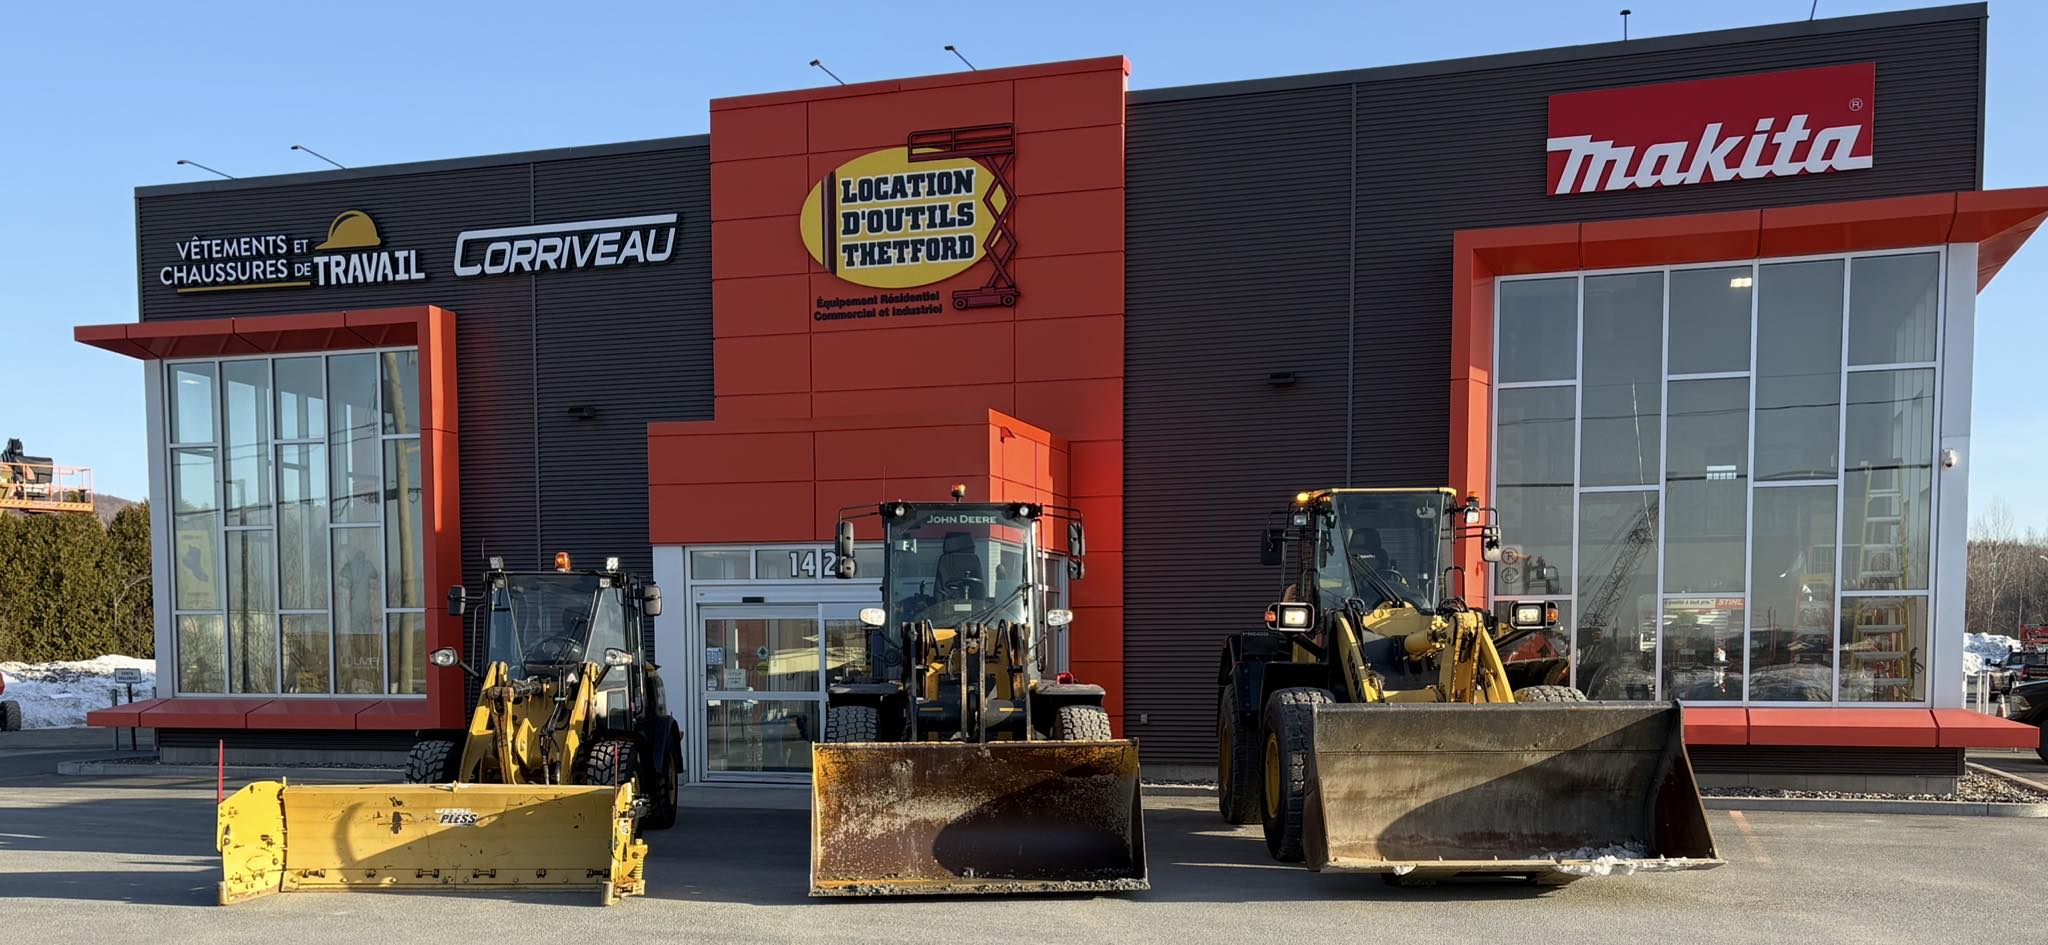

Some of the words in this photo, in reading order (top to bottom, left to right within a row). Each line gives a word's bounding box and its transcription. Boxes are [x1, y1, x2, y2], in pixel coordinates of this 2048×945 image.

[840, 168, 976, 204] LOCATION
[840, 201, 976, 237] D'OUTILS
[176, 235, 287, 261] VÊTEMENTS
[294, 239, 309, 253] ET
[453, 213, 678, 277] CORRIVEAU
[840, 233, 976, 268] THETFORD
[159, 259, 288, 286] CHAUSSURES
[294, 262, 312, 277] DE
[313, 250, 426, 286] TRAVAIL
[814, 308, 876, 321] Commercial
[878, 307, 890, 317] et
[892, 304, 942, 317] Industriel
[816, 295, 878, 310] Équipement
[880, 291, 939, 305] Résidentiel
[927, 515, 957, 524] JOHN
[959, 514, 997, 524] DEERE
[440, 814, 477, 824] PLESS
